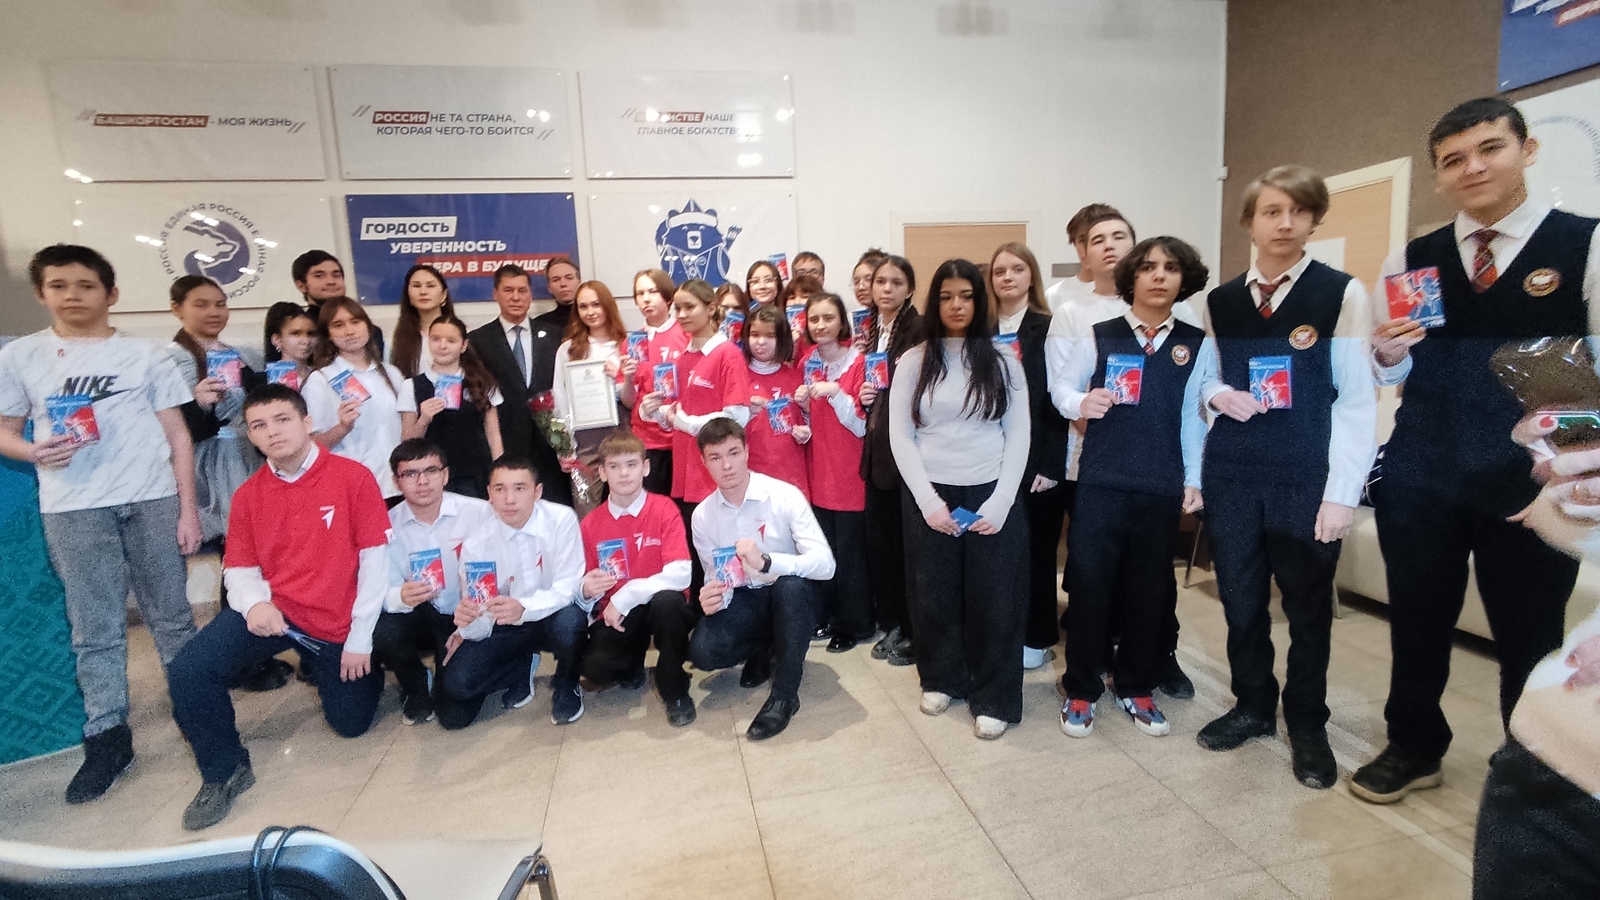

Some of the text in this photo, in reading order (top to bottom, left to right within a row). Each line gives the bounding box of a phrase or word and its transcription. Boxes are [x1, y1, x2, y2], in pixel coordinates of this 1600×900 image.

[96, 116, 206, 127] БАШКОРТОСТАН
[218, 117, 245, 126] МОЯ
[248, 118, 292, 127] ЖИЗНЬ
[375, 113, 516, 124] РОССИЯ НЕ ТА СТРАНА,
[376, 126, 534, 135] КОТОРАЯ ЧЕГО-ТО БОИТСЯ
[637, 126, 685, 135] ГЛАВНОЕ
[209, 203, 254, 229] РОССИЯ
[365, 222, 450, 235] ГОРДОСТЬ
[390, 240, 507, 254] УВЕРЕННОСТЬ
[467, 261, 478, 272] В
[62, 375, 118, 396] NIKE
